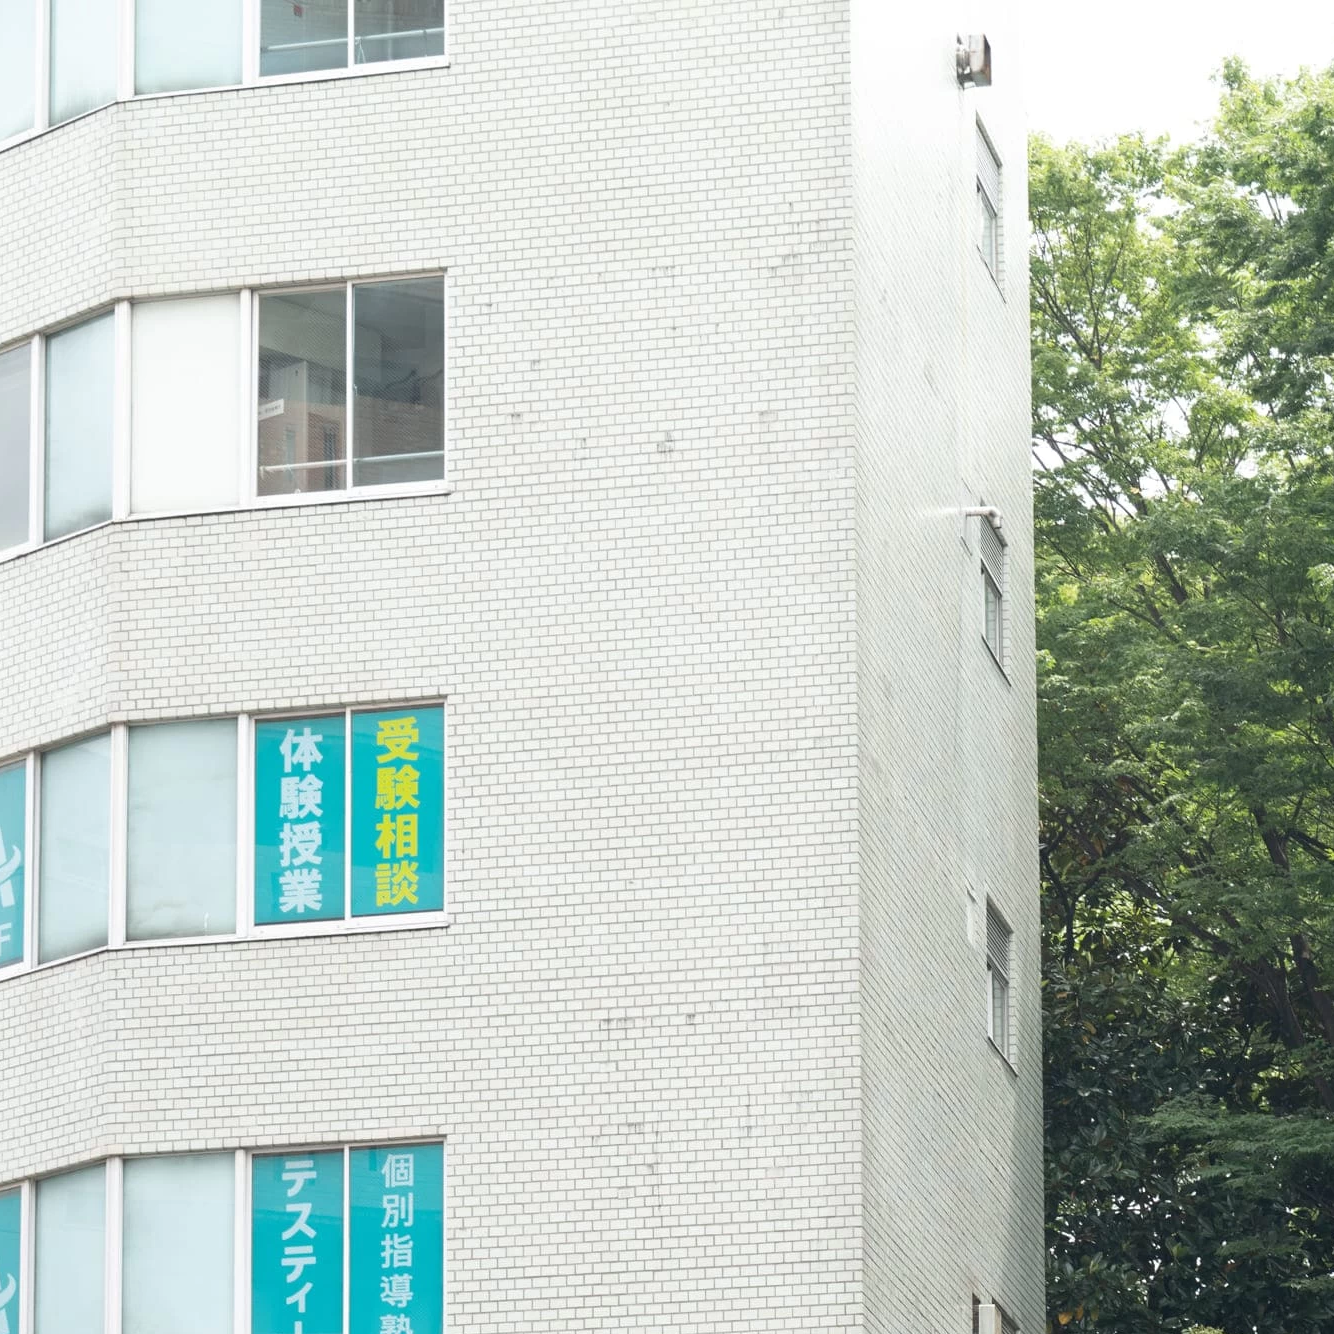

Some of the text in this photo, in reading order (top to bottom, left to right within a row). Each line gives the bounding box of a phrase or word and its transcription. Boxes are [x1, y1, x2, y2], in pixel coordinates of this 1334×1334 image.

[279, 727, 323, 913] 体験授業
[375, 716, 420, 907] 受験相談
